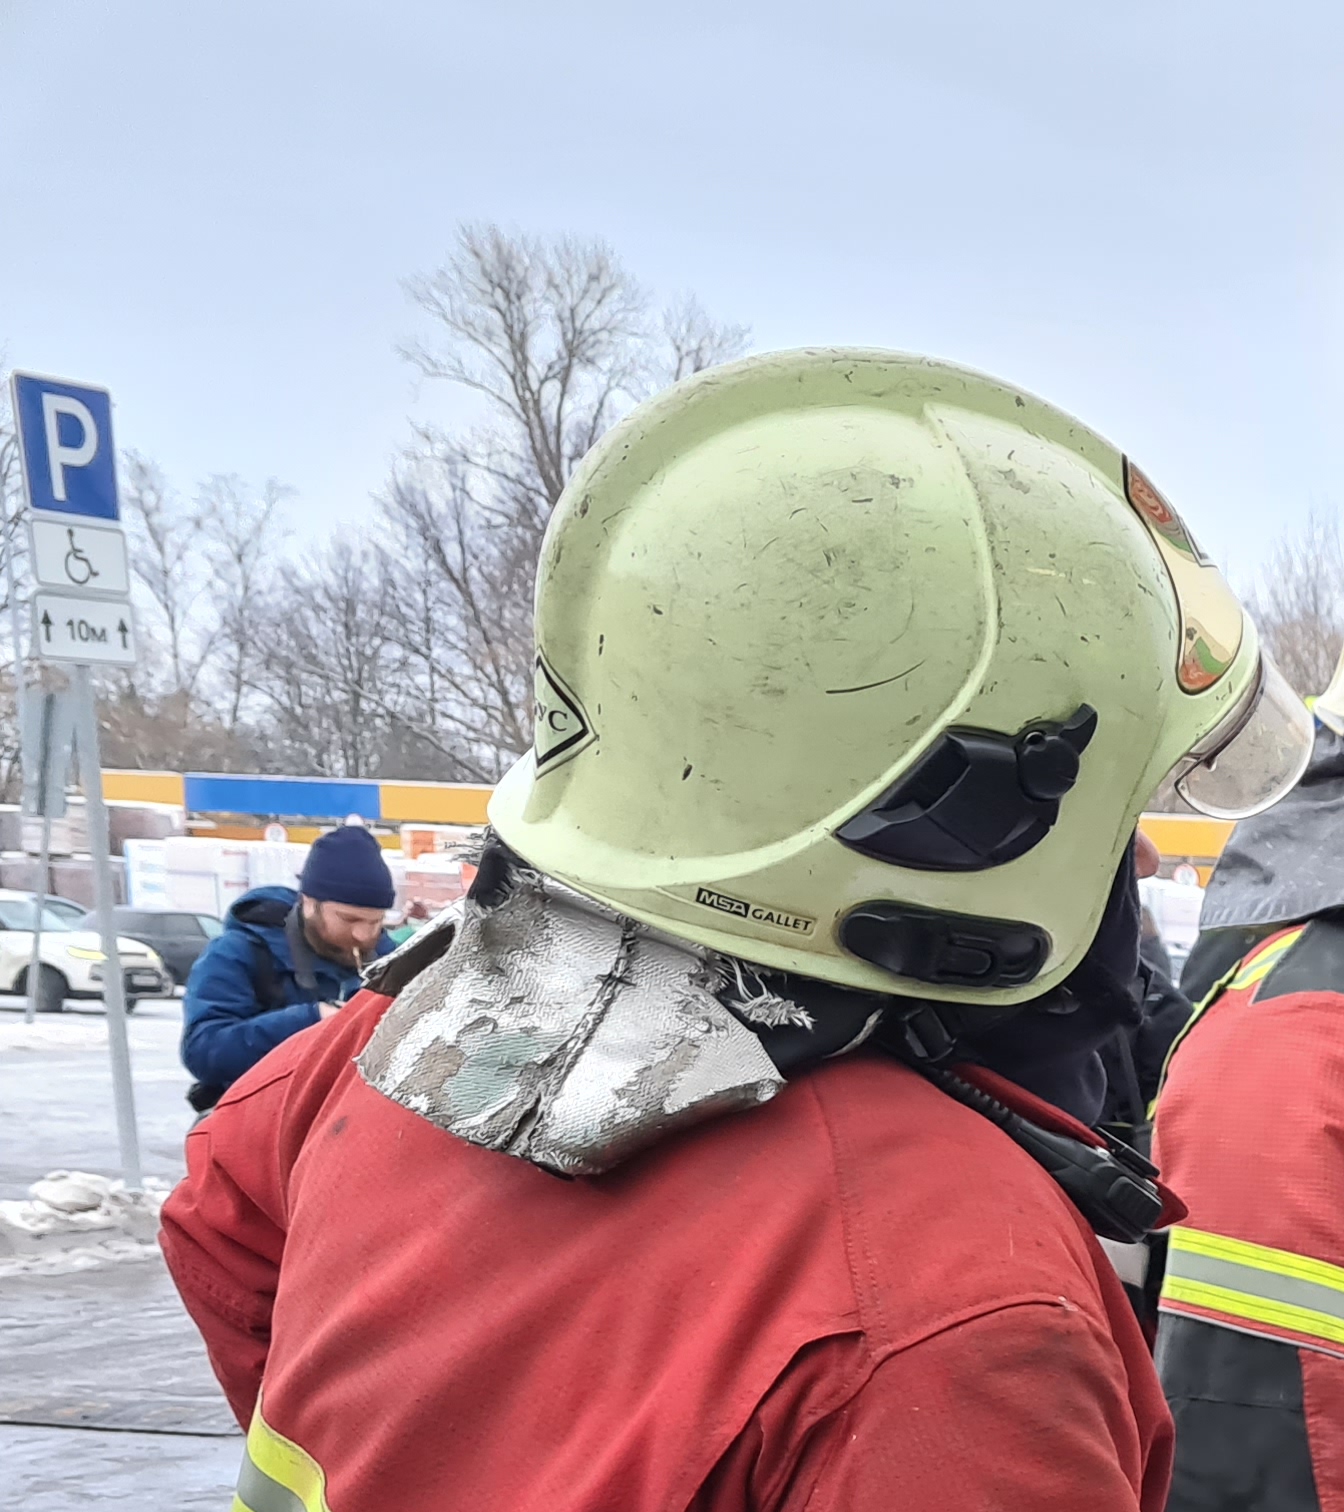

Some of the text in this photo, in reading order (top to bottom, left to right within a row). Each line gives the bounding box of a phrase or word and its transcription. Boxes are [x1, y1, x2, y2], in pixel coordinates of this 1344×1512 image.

[42, 391, 98, 501] P
[699, 890, 812, 931] MSA GALLET
